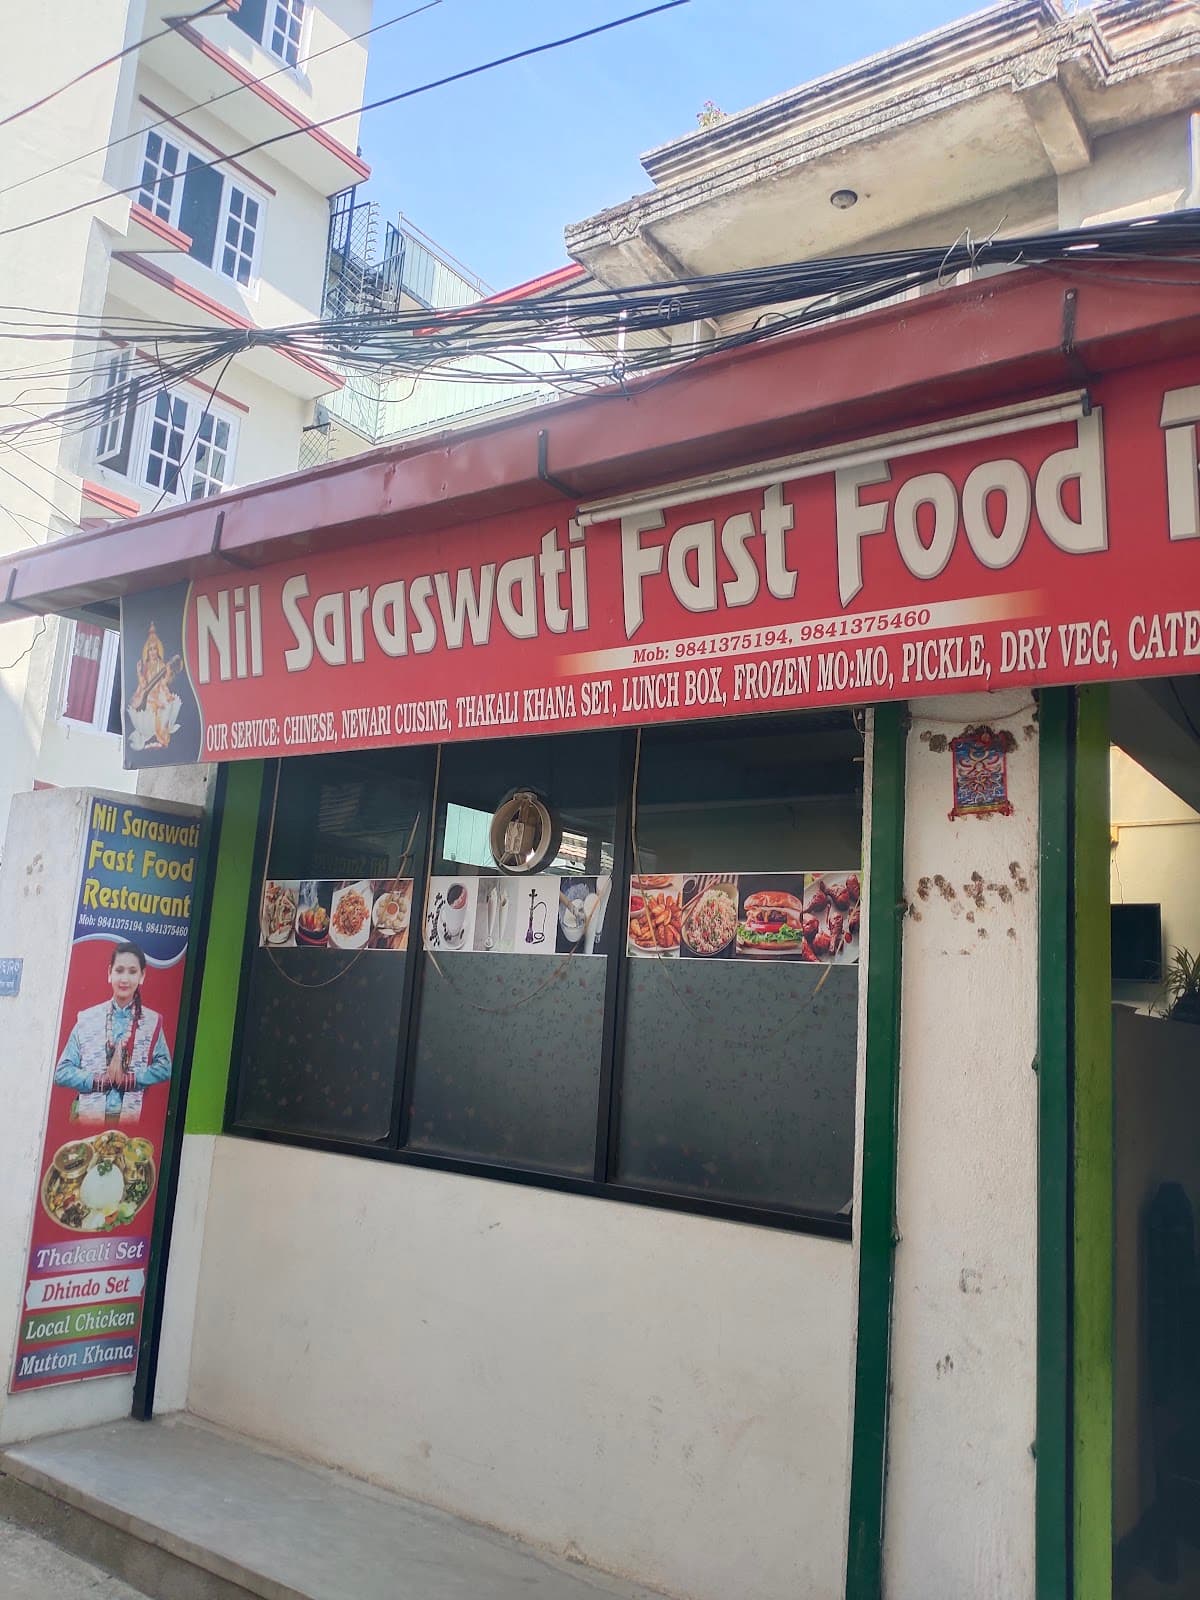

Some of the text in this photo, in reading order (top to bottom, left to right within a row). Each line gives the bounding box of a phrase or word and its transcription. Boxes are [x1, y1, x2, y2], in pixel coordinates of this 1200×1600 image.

[196, 583, 264, 685] Nil
[281, 518, 590, 673] Saraswati
[620, 481, 799, 641] Fast
[834, 405, 1110, 609] Food
[632, 609, 931, 664] Mob: 9841375194, 9841375460
[207, 723, 228, 751] OUR
[231, 718, 280, 749] SERVICE:
[283, 711, 338, 744] CHINESE,
[341, 705, 391, 739] NEWARI
[395, 699, 452, 734] CUISINE,
[456, 690, 519, 728] THAKALI
[523, 684, 577, 722] KHANA
[581, 680, 617, 717] SET,
[622, 671, 680, 712] LUNCH
[685, 666, 727, 708] BOX,
[733, 655, 812, 701] FROZEN
[817, 645, 895, 690] MO:MO,
[902, 634, 991, 683] PICKLE,
[1000, 626, 1052, 673] DRY
[1058, 619, 1118, 669] VEG,
[92, 802, 200, 848] Nil Saraswati
[88, 840, 195, 882] Fast Food
[83, 878, 191, 918] Restaurant
[78, 913, 95, 926] Mob:
[146, 922, 189, 937] 9841375460
[37, 1240, 145, 1269] Thakali Set
[42, 1276, 130, 1302] Dhindo Set
[25, 1310, 135, 1340] Local Chicken
[18, 1344, 134, 1376] Mutton Khana
